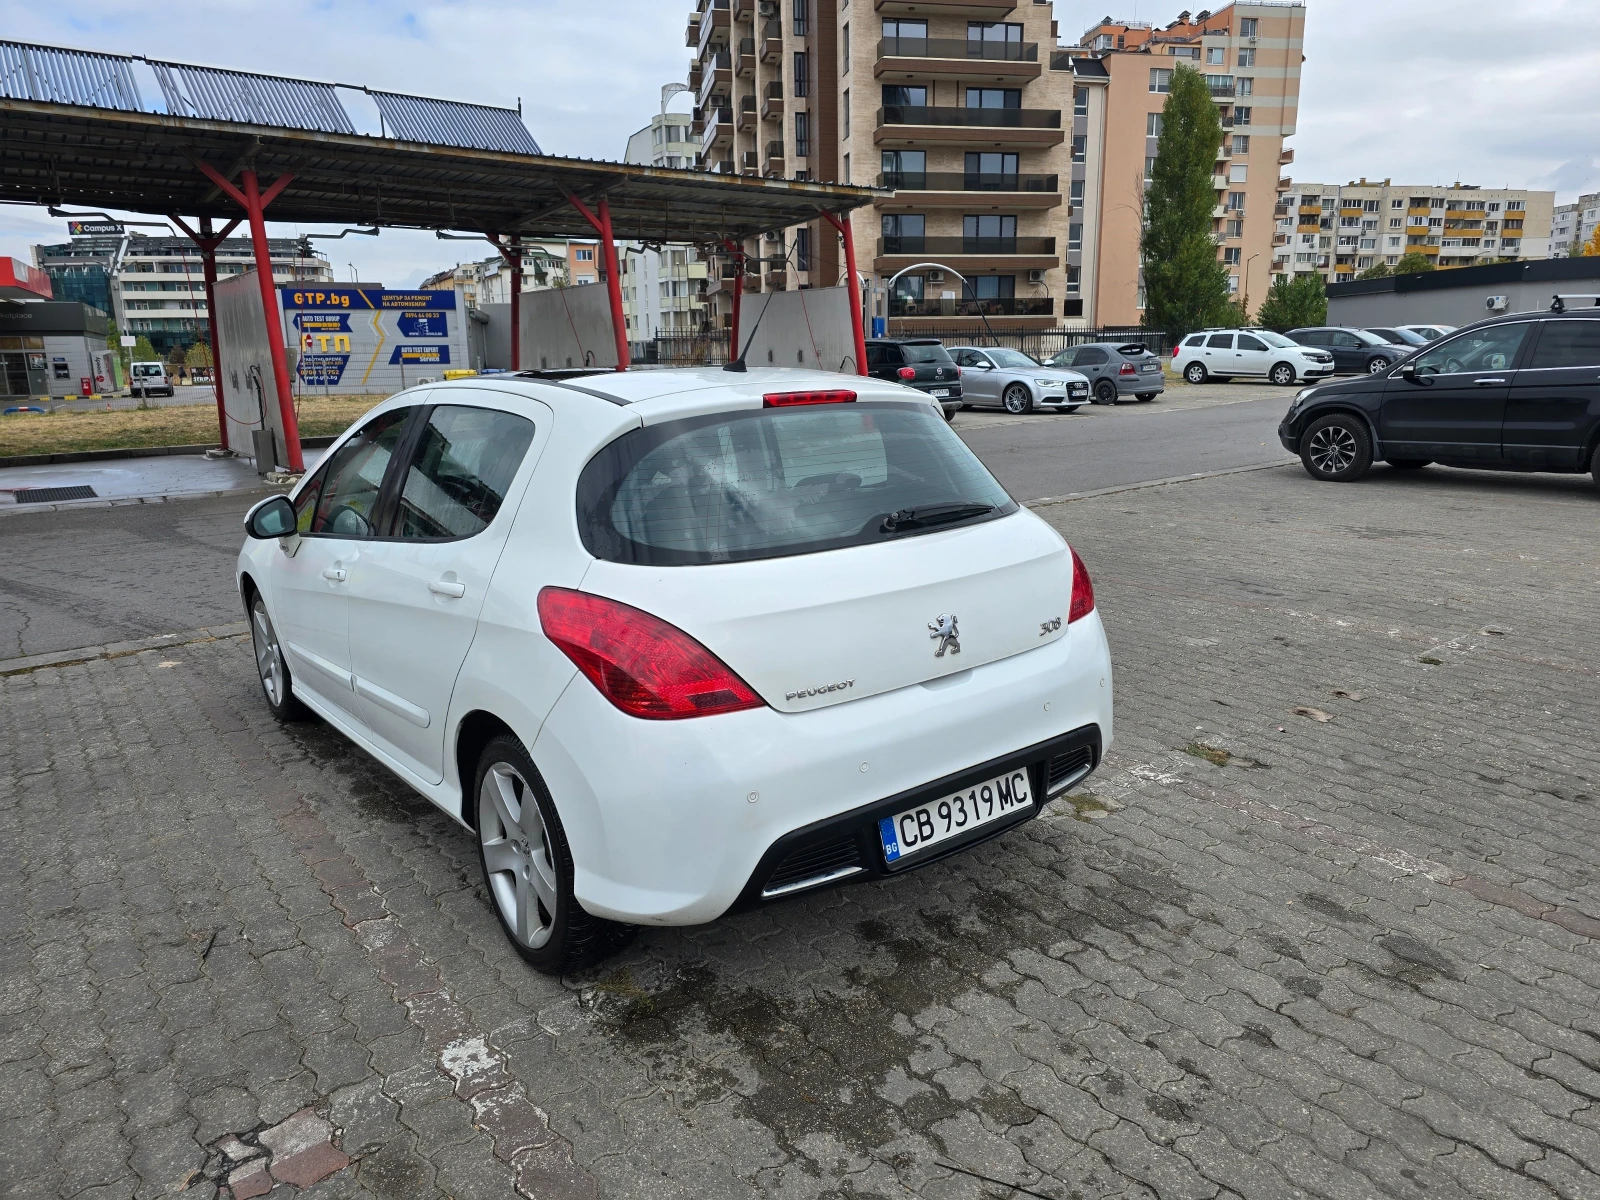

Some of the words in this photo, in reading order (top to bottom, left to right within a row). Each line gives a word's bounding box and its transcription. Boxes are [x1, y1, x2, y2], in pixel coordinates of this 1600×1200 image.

[84, 224, 115, 232] Campus
[294, 292, 350, 307] GTP.bg
[1039, 616, 1061, 636] 308
[786, 678, 855, 701] PEUGEOT
[900, 808, 934, 847] CB
[938, 786, 994, 833] 9319
[996, 772, 1027, 811] MC
[886, 842, 898, 854] BG
